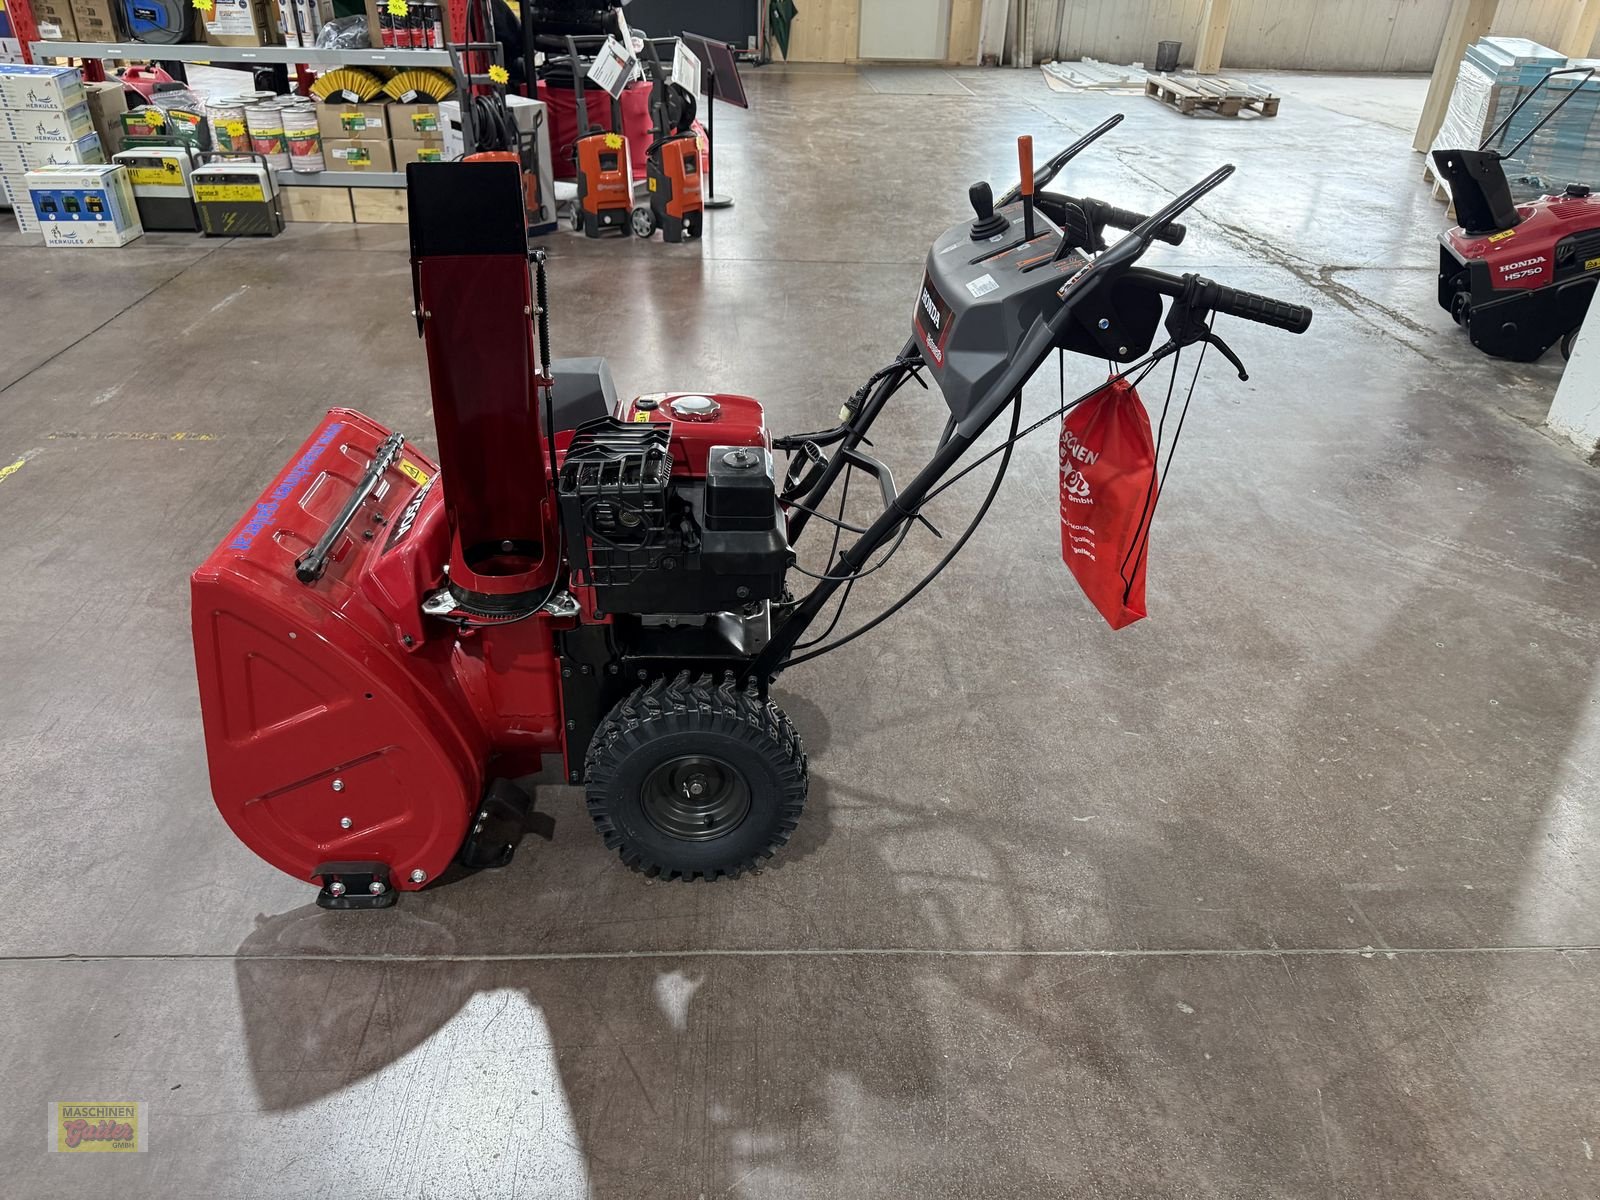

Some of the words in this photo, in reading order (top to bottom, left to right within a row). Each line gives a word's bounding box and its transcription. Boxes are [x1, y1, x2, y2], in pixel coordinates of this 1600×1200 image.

[1499, 256, 1547, 273] HONDA
[1504, 267, 1543, 281] HS750
[921, 287, 940, 329] HONDA
